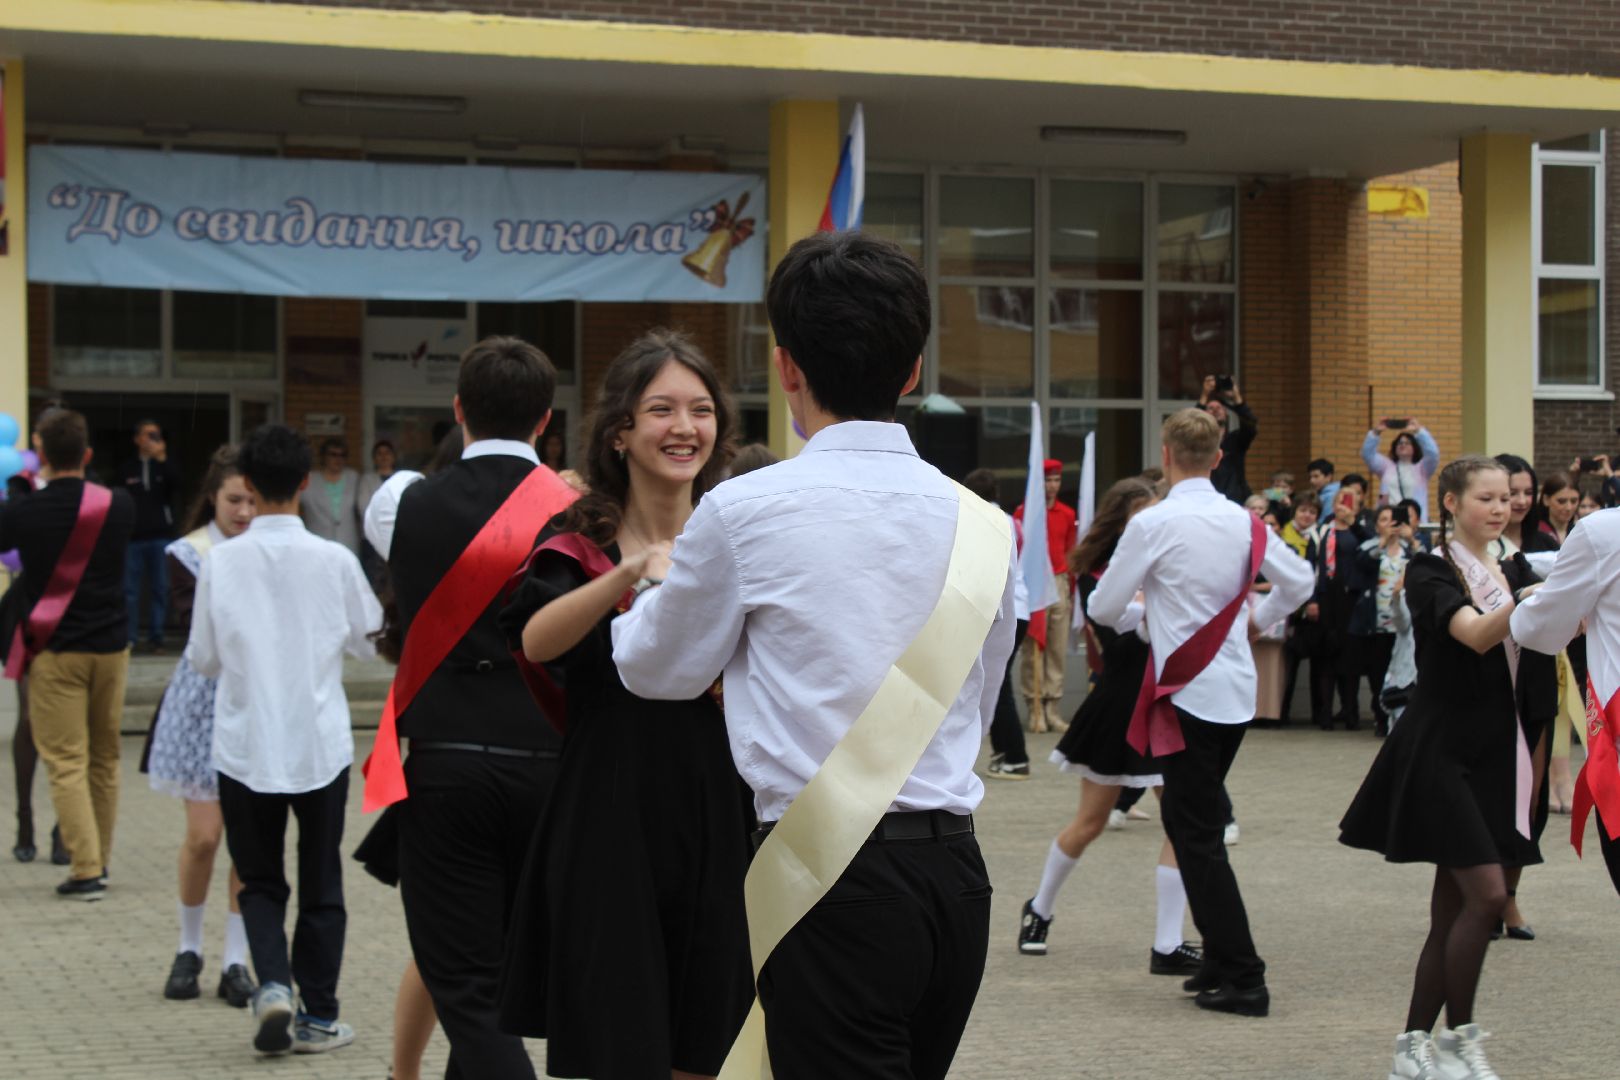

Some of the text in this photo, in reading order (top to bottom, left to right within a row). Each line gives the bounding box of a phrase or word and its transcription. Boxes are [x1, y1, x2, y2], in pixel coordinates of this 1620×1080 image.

[49, 184, 715, 261] “До свидания, школа”
